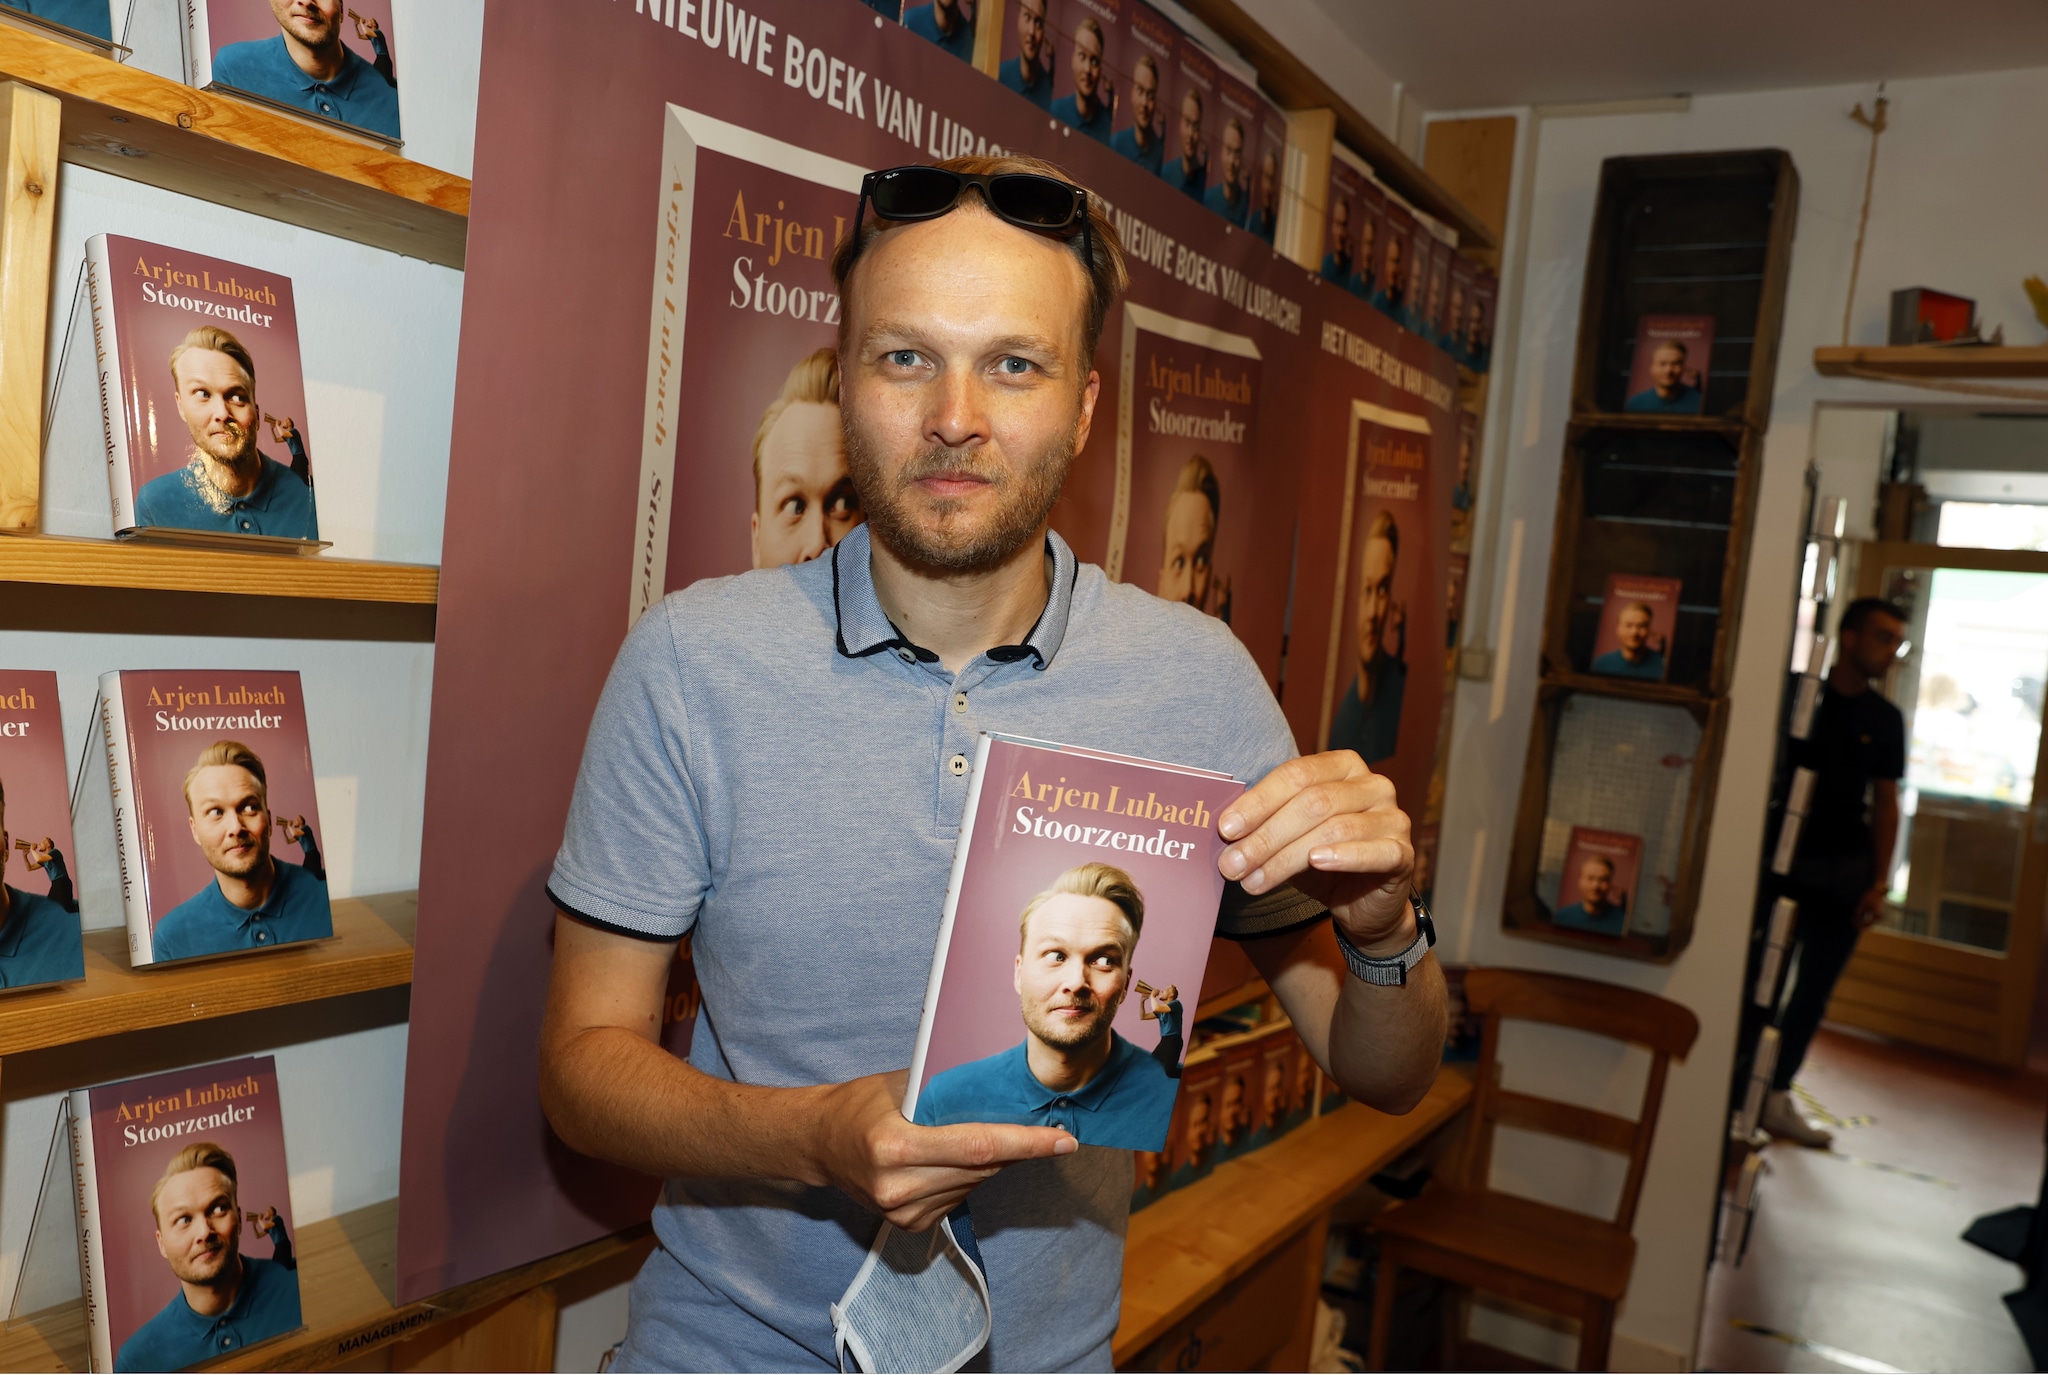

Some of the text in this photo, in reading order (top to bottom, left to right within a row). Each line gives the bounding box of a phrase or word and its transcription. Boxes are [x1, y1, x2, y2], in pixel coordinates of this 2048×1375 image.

[784, 34, 867, 120] BOEK
[874, 78, 923, 149] VAN
[928, 110, 1010, 160] LUBA
[666, 162, 684, 286] Arjen
[722, 189, 825, 267] Arjen
[133, 256, 278, 307] Arjen Lubach
[1115, 207, 1175, 276] NIEUWE
[1175, 243, 1219, 297] BOEK
[1221, 265, 1248, 310] VAN
[142, 282, 273, 328] Stoorzender
[88, 261, 116, 467] Arjen Lubach Stoorzender
[655, 295, 677, 447] Lubach
[1145, 353, 1252, 406] Arjen Lubach
[1148, 396, 1247, 444] Stoorzender
[146, 685, 286, 712] Arjen Lubach
[155, 710, 282, 732] Stoorzender
[101, 696, 131, 902] Arjen Lubach Stoorzender
[1010, 771, 1212, 829] Arjen Lubach
[1012, 806, 1196, 861] Stoorzender
[115, 1076, 260, 1123] Arjen Lubach
[124, 1105, 256, 1148] Stoorzender
[71, 1115, 97, 1327] Arjen Lubach Stoorzender
[338, 1308, 437, 1355] MANAGEMENT
